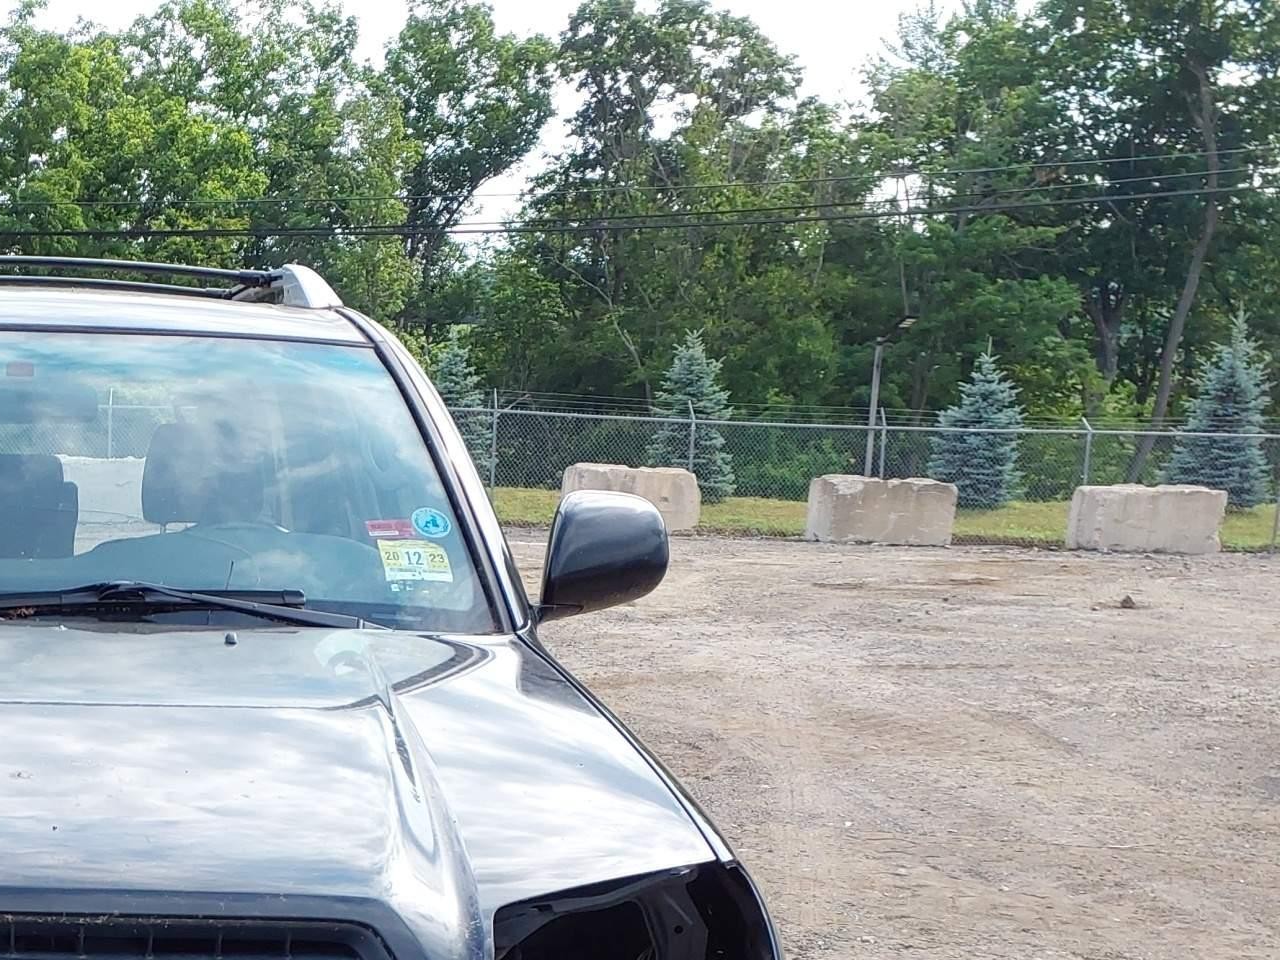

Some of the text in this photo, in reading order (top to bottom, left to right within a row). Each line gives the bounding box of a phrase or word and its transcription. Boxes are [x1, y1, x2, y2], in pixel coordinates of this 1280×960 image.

[384, 551, 400, 561] 20
[404, 550, 424, 566] 12
[428, 553, 445, 563] 23
